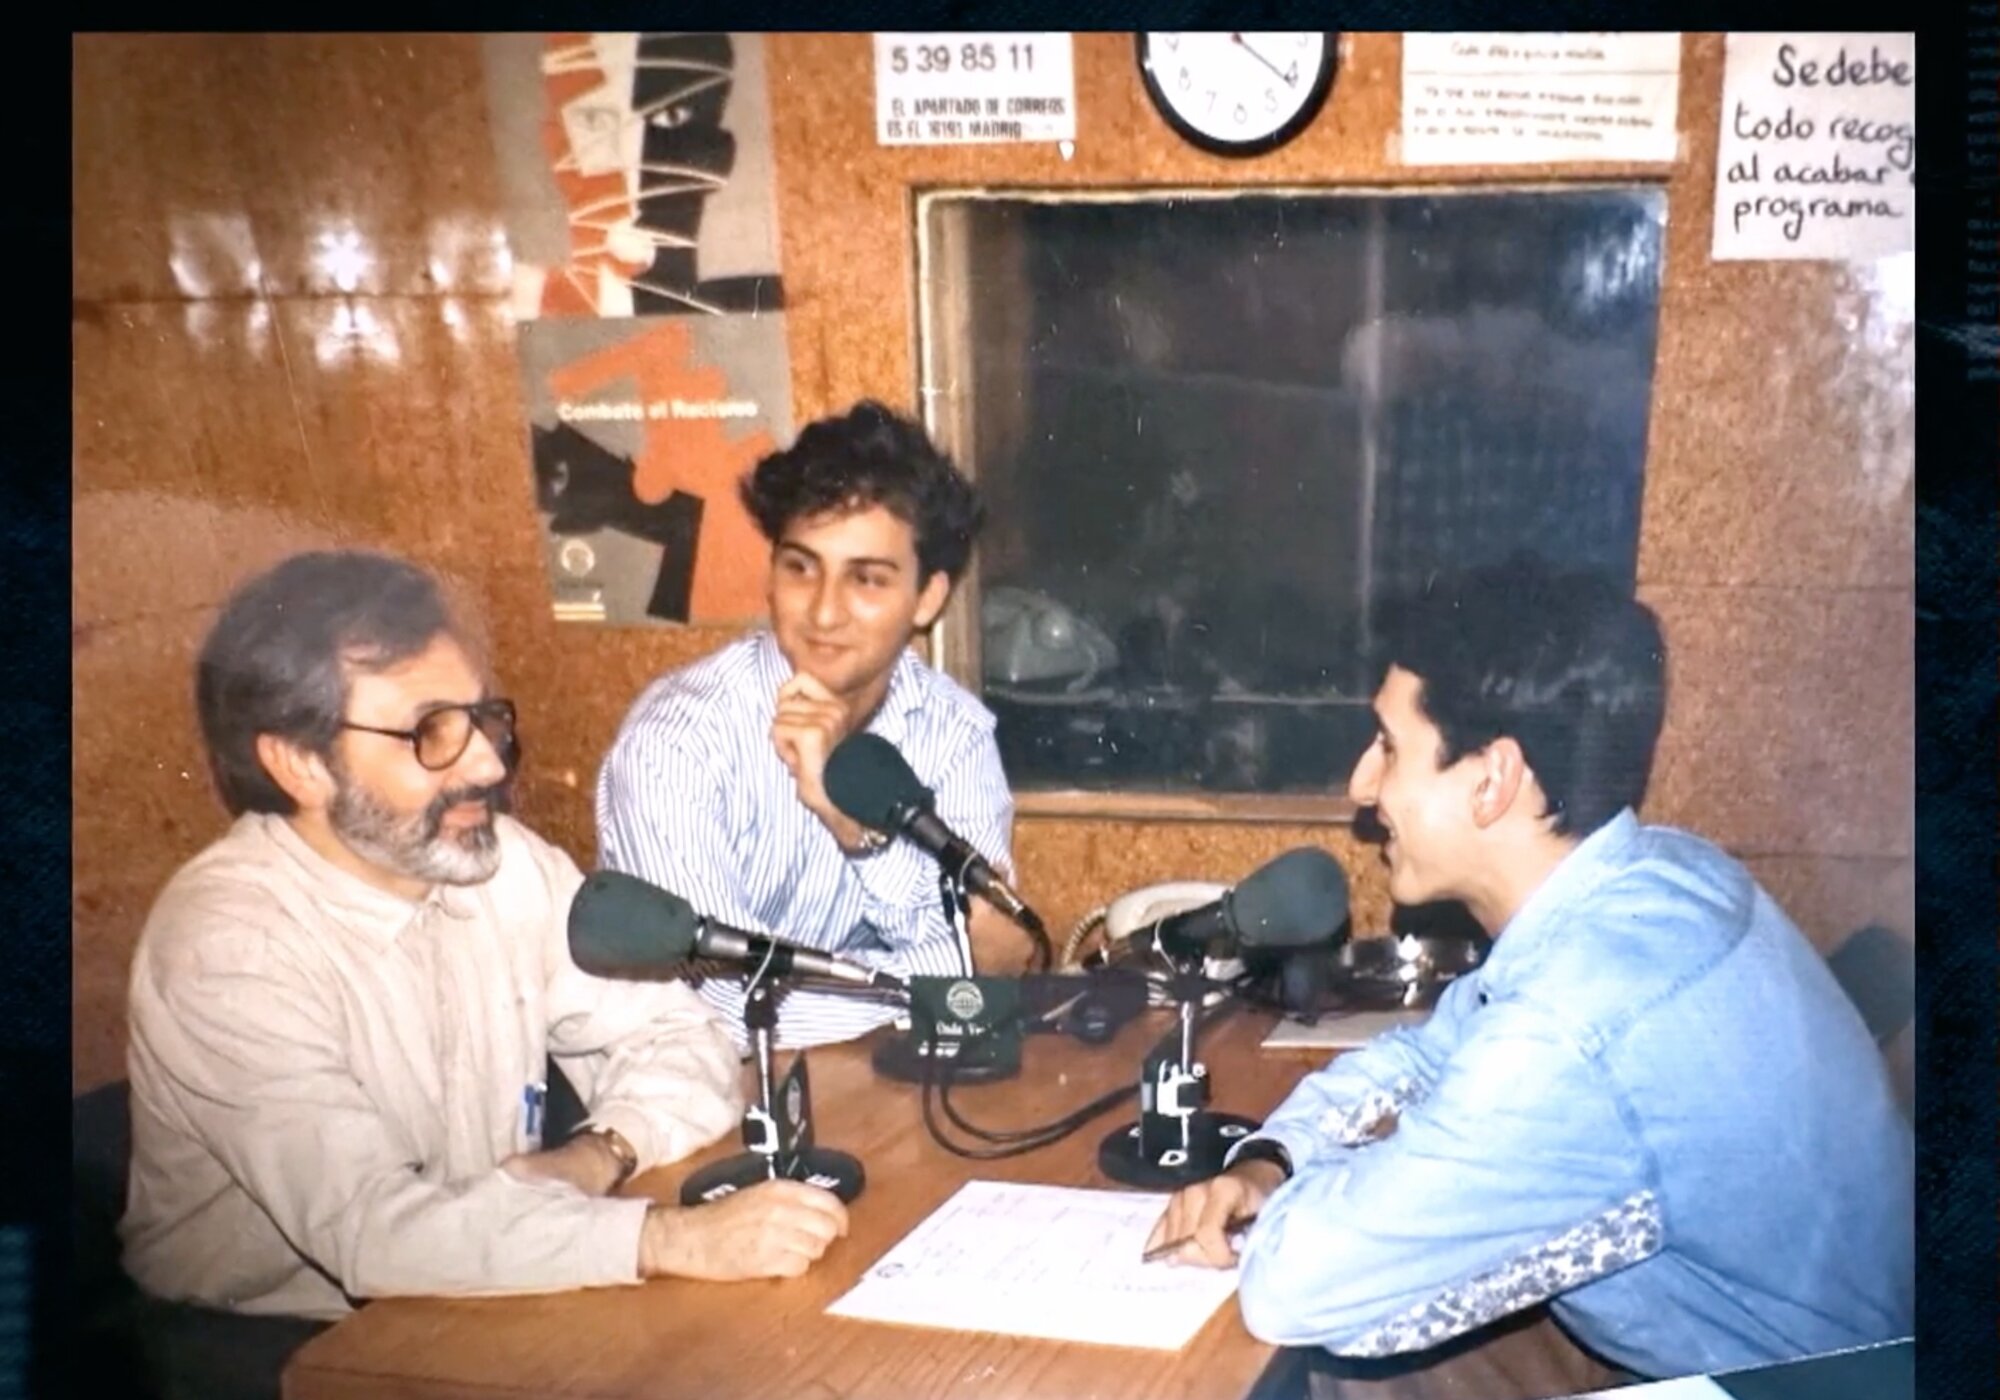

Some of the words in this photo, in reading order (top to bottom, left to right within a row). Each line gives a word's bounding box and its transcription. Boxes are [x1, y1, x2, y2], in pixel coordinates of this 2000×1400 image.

[891, 46, 909, 73] 5
[916, 45, 950, 72] 39
[960, 43, 996, 71] 85
[1009, 44, 1033, 71] 11
[892, 98, 905, 117] EL
[914, 97, 981, 116] APARTADO
[986, 97, 999, 115] DE
[1007, 97, 1066, 115] CORREOS
[1206, 89, 1217, 113] 7
[1265, 88, 1279, 113] 5
[887, 120, 902, 138] ES
[907, 121, 920, 138] EL
[969, 120, 1022, 139] MADRID
[1734, 100, 1814, 140] todo
[1727, 153, 1760, 183] al
[1774, 153, 1891, 185] acabar
[1733, 196, 1902, 241] programa
[557, 403, 644, 421] Combate
